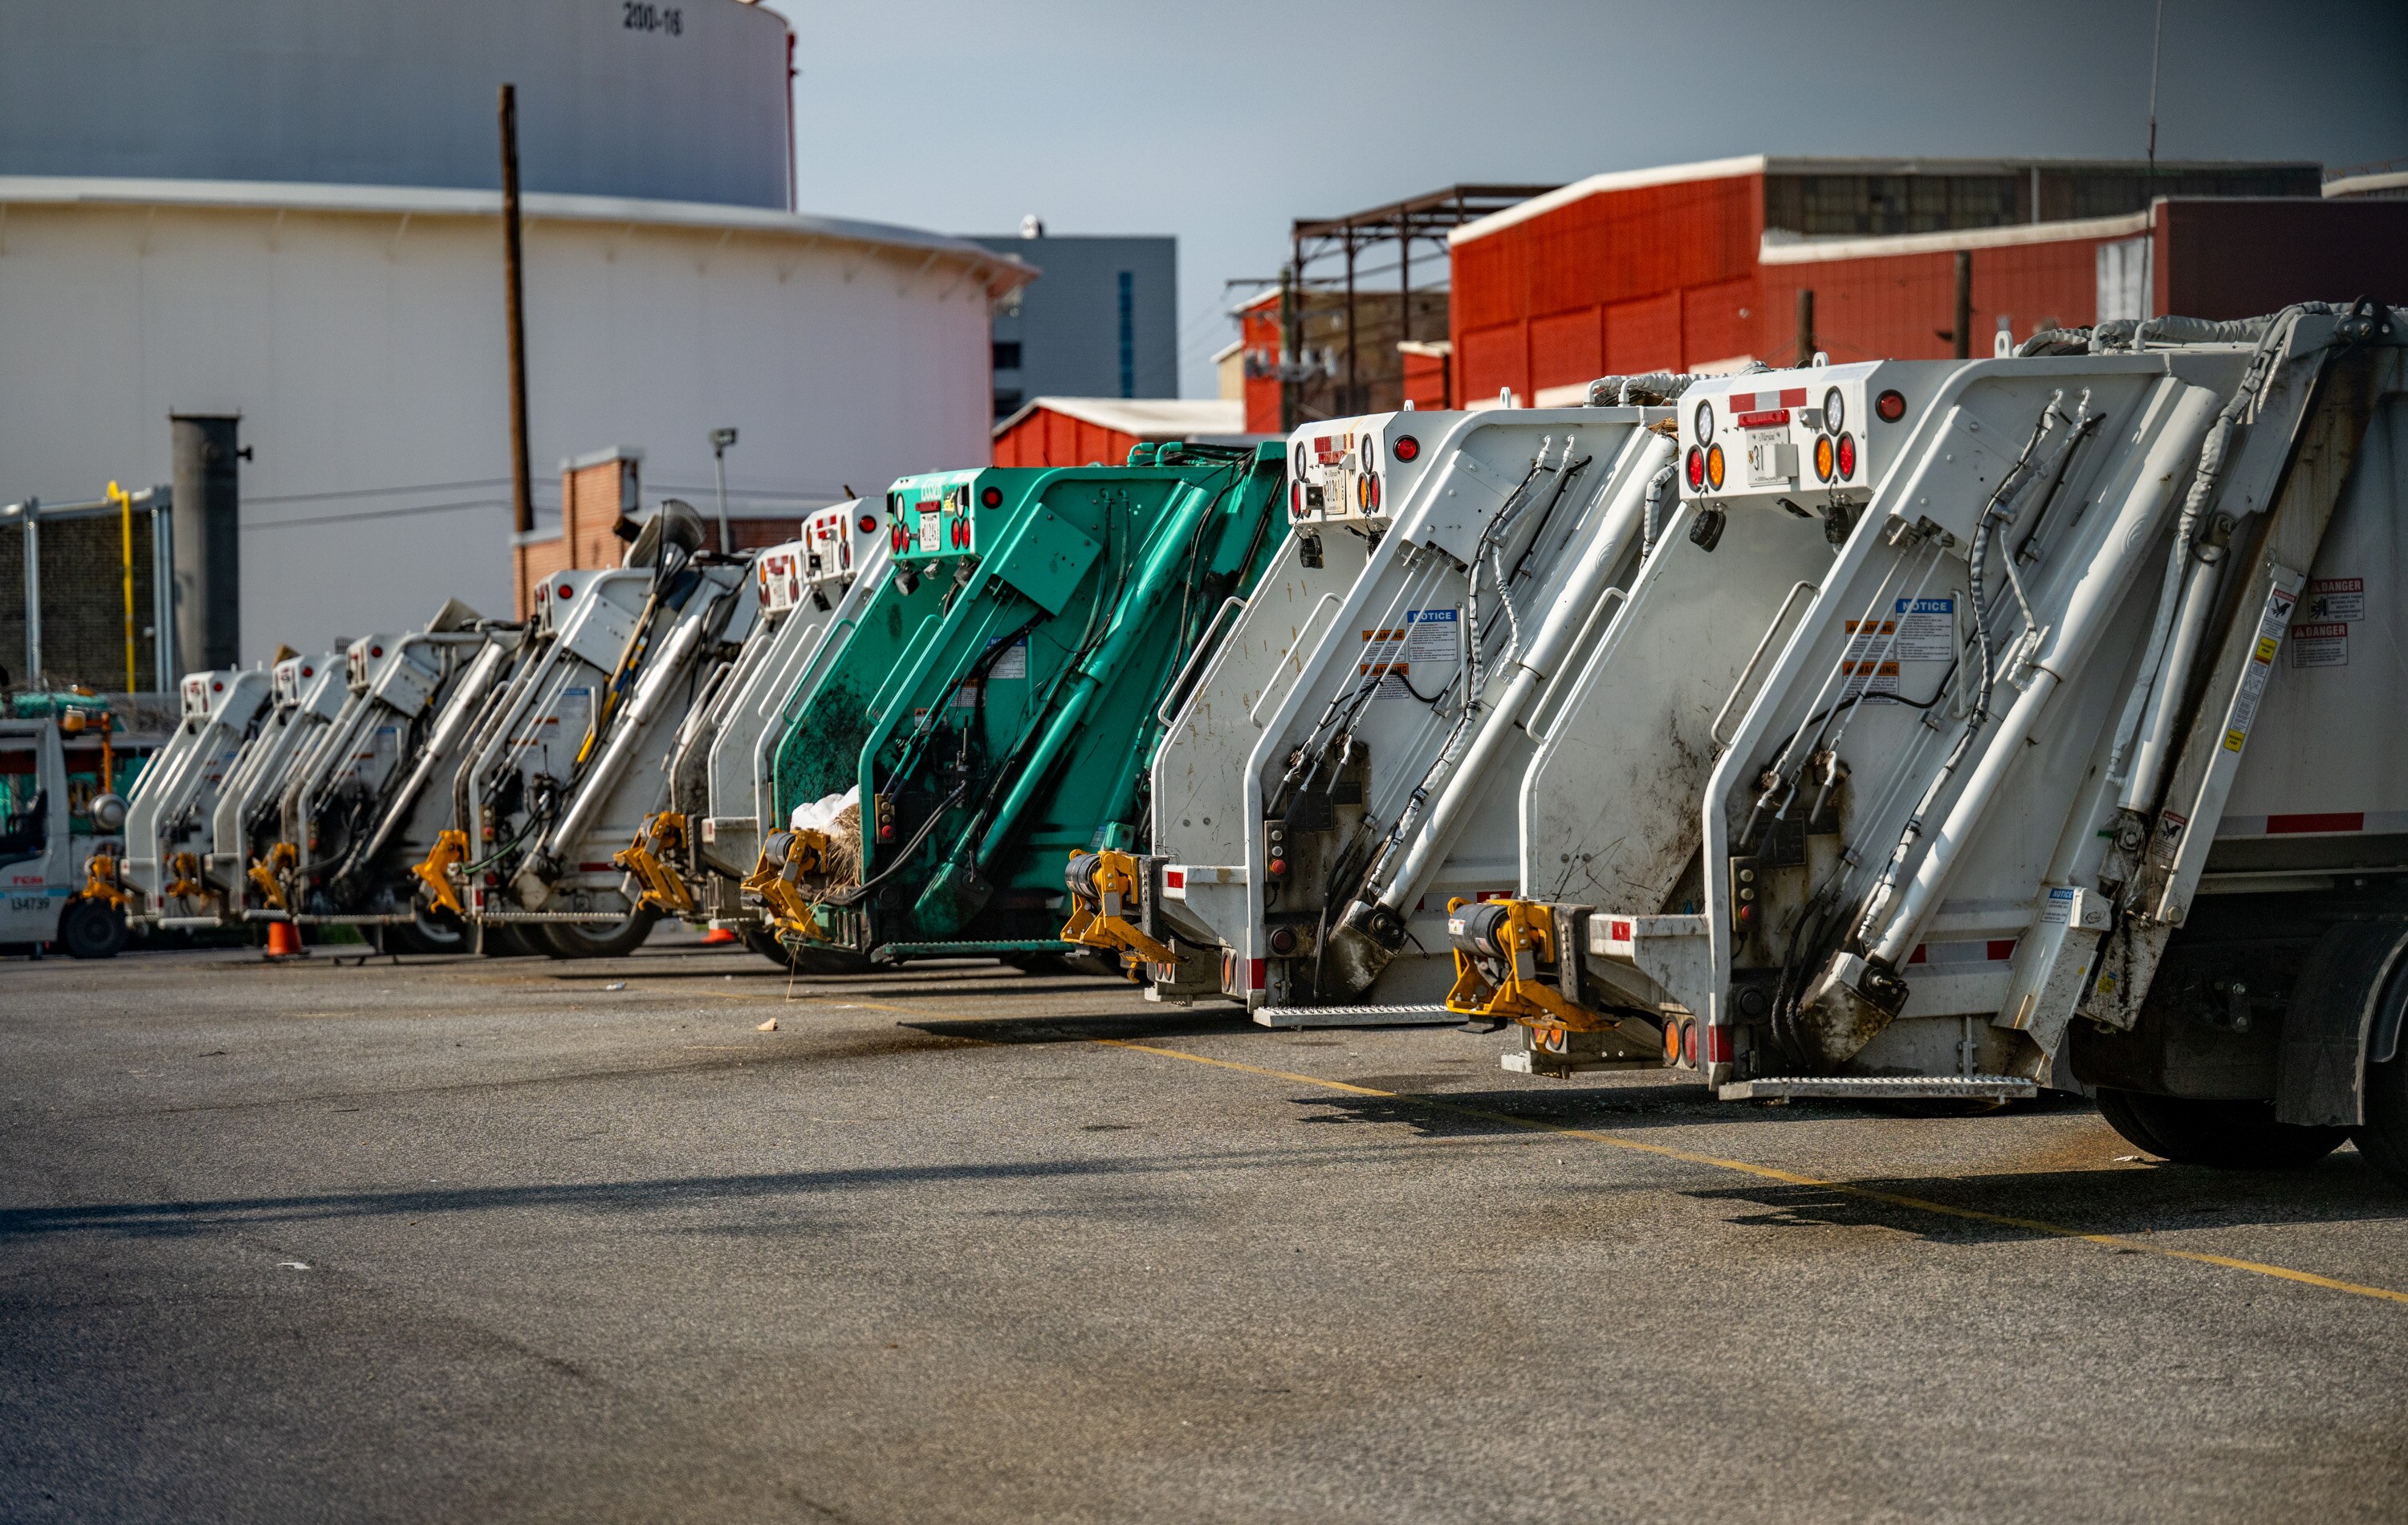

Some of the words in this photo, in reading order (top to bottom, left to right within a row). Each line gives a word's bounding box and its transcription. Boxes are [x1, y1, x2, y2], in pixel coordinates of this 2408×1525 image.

[2321, 580, 2361, 592] DANGER
[1902, 602, 1947, 611] NOTICE
[1413, 612, 1451, 620] NOTICE
[2305, 625, 2345, 636] DANGER
[2052, 890, 2073, 898] NOTICE
